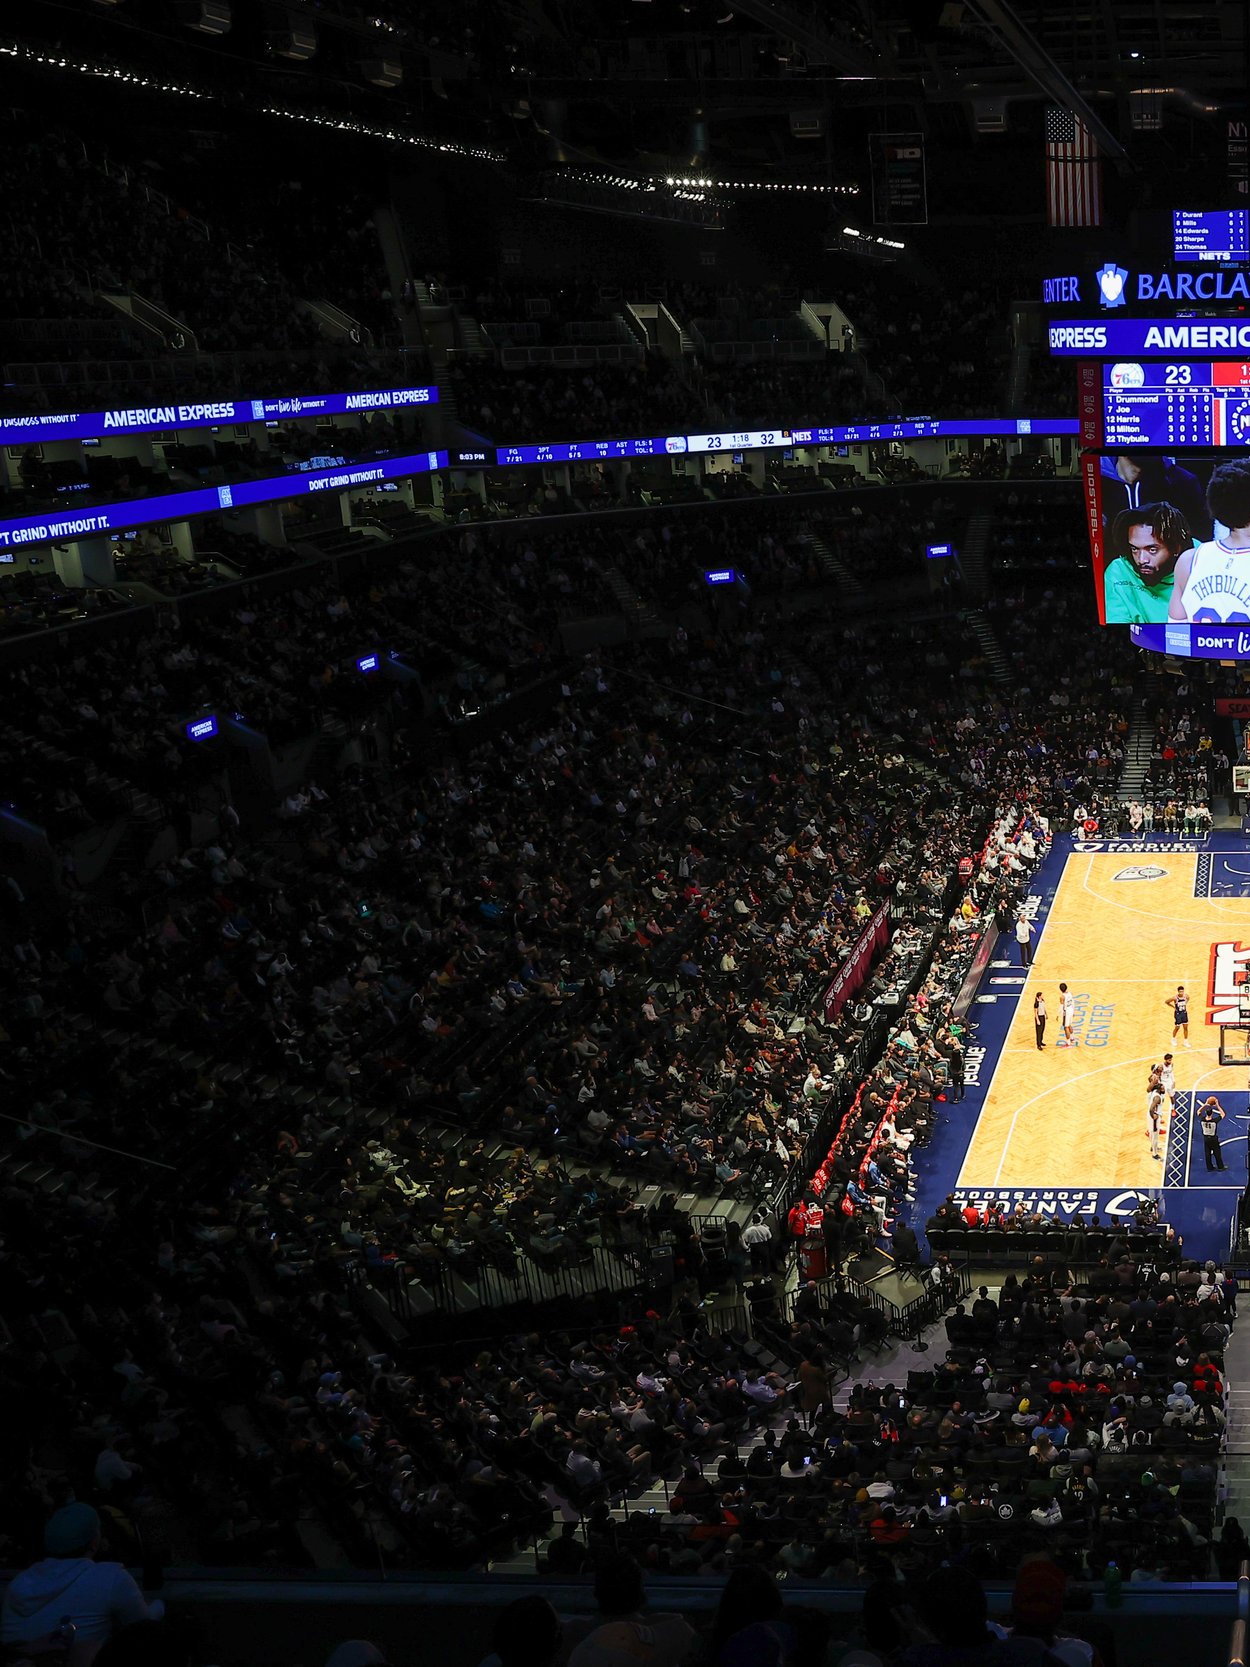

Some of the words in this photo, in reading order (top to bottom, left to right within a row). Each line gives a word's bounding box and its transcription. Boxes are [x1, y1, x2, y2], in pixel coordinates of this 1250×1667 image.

[1199, 252, 1231, 261] NETS
[1050, 326, 1107, 348] EXPRESS
[1165, 365, 1192, 385] 23
[346, 393, 391, 410] AMERICAN
[392, 389, 430, 404] EXPRESS
[265, 403, 279, 412] DON'T
[39, 414, 70, 425] WITHOUT
[103, 406, 176, 429] AMERICAN
[179, 402, 235, 421] EXPRESS
[1116, 425, 1140, 433] Milton
[707, 437, 722, 449] 23
[732, 433, 750, 443] 1:18
[760, 433, 775, 445] 32
[792, 430, 813, 444] NETS
[1116, 435, 1150, 444] Thybulle
[459, 453, 473, 461] 8:03
[474, 453, 485, 461] PM
[308, 478, 329, 492] DON'T
[329, 475, 350, 488] GRIND
[349, 470, 377, 484] WITHOUT
[1086, 462, 1098, 538] BIOSTEEL
[12, 526, 48, 543] GRIND
[48, 518, 96, 537] WITHOUT
[97, 515, 110, 529] IT.
[1197, 637, 1234, 649] DON'T
[1084, 1003, 1117, 1048] CENTER
[953, 1190, 1099, 1201] SPORTSBOOK
